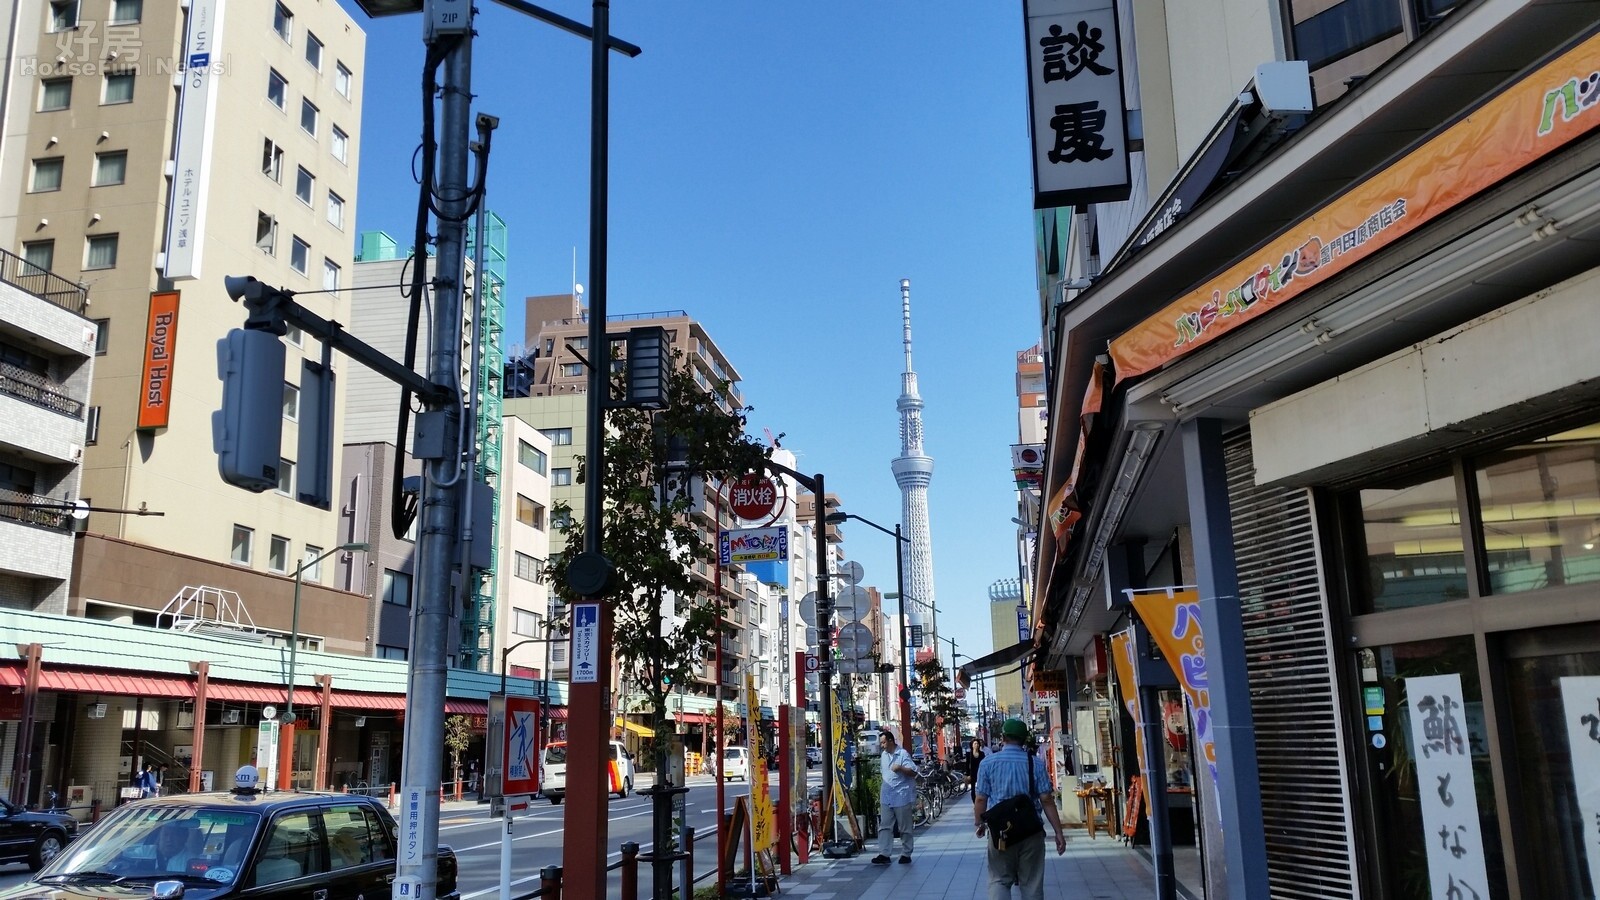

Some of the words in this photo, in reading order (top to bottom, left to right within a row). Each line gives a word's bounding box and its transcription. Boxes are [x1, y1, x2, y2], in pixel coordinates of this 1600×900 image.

[150, 311, 173, 360] Royal
[147, 364, 168, 408] Host
[733, 486, 773, 507] 消火栓
[779, 530, 787, 558] スロット
[407, 792, 420, 860] 音響用押ボタン
